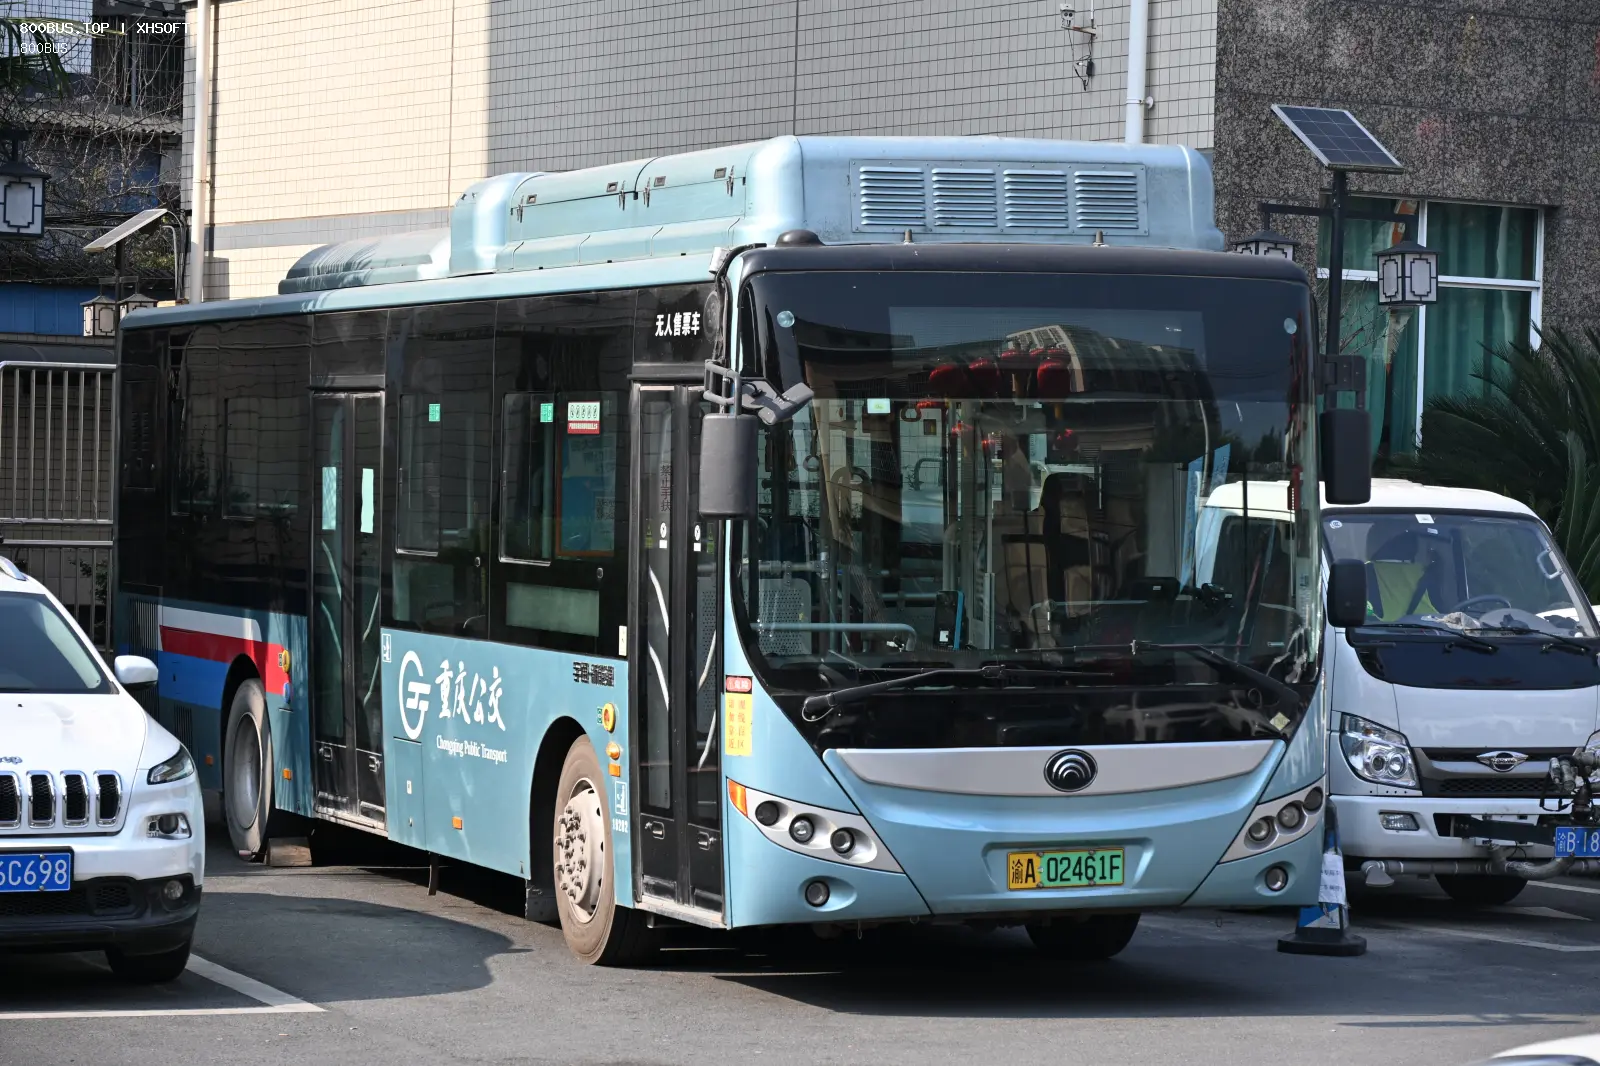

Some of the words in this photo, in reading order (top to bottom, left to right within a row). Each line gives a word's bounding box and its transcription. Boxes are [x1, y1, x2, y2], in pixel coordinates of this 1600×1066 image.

[654, 311, 701, 337] 无人售票车
[435, 659, 506, 731] 重庆公交
[436, 734, 464, 758] Chongqing
[464, 740, 481, 757] Public
[480, 743, 508, 765] Transport
